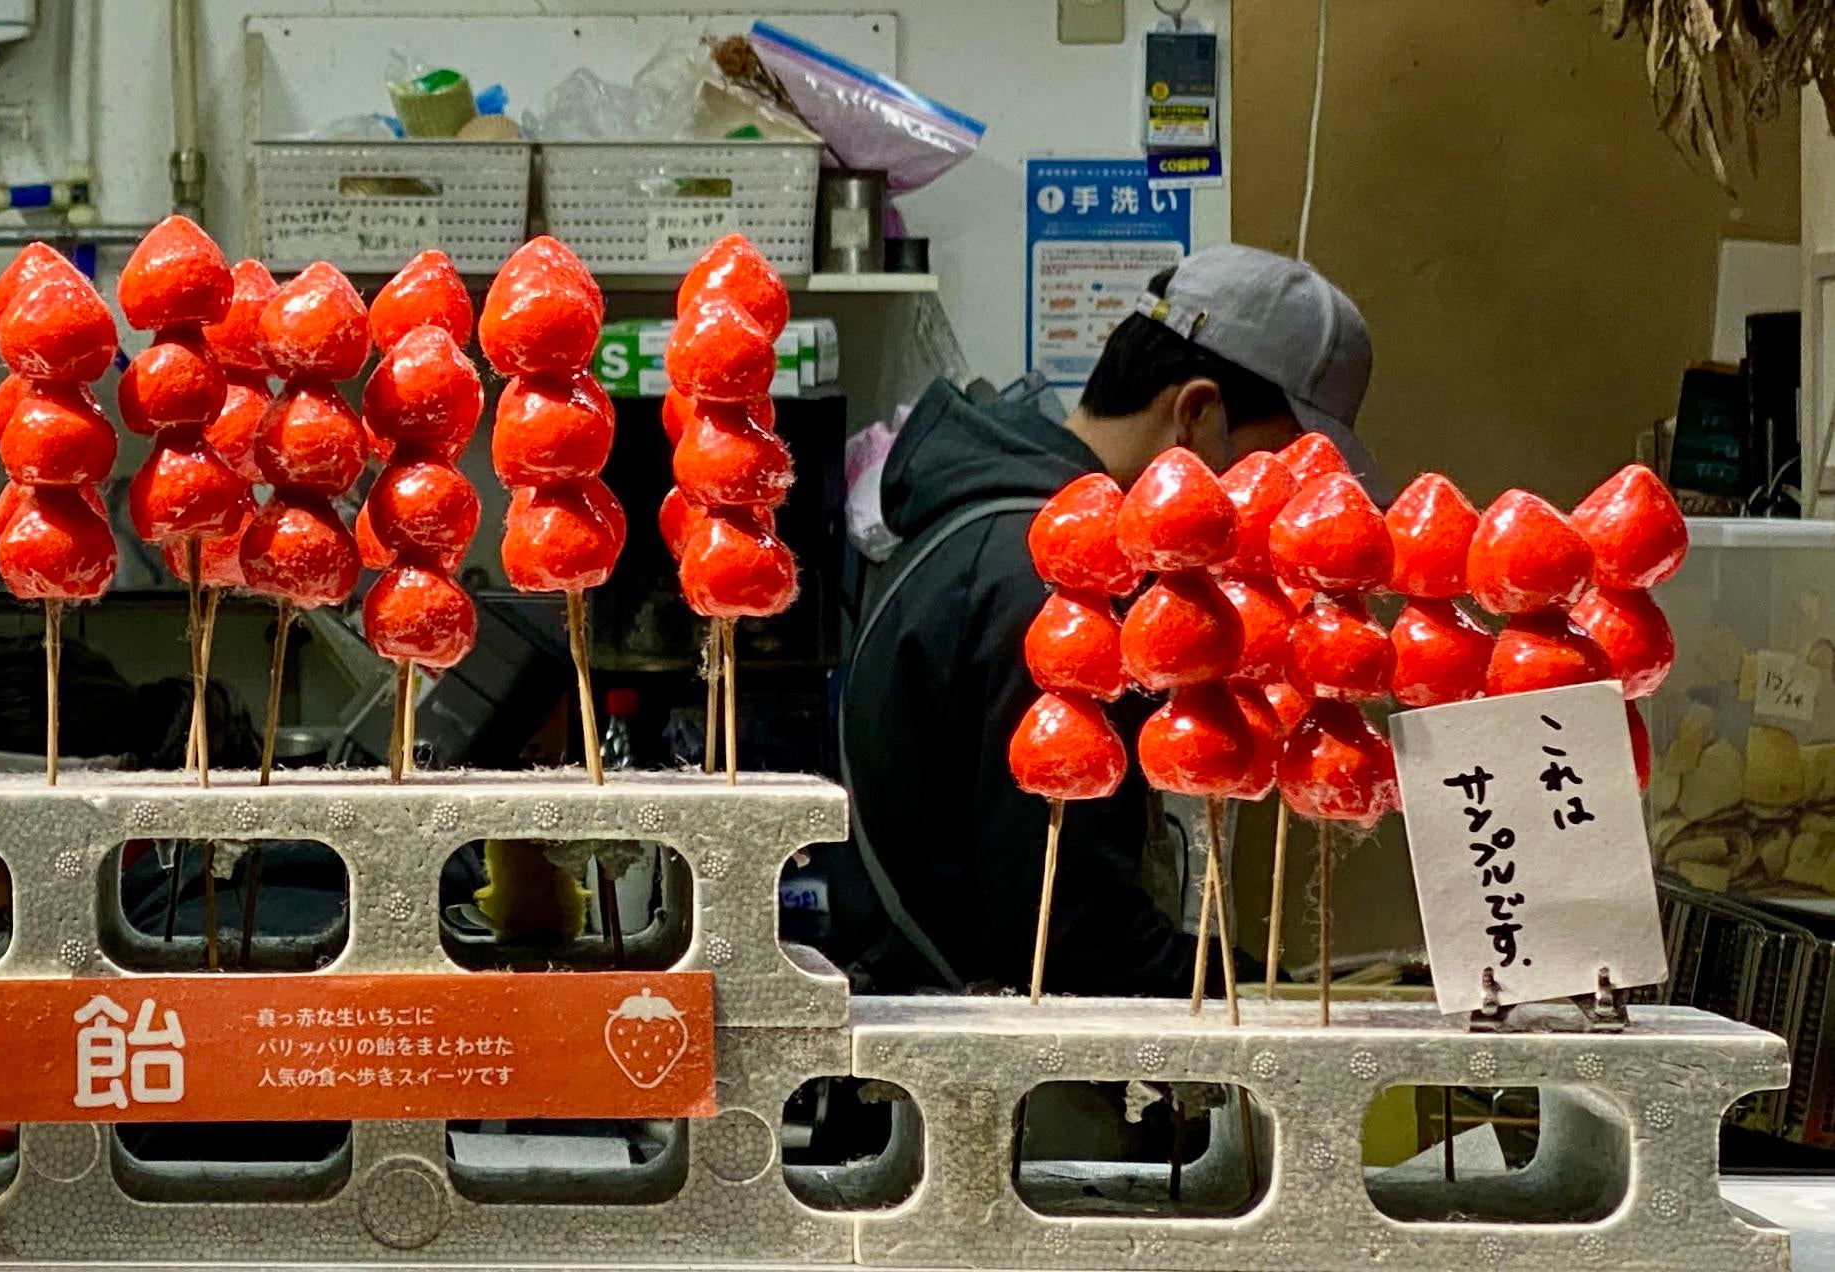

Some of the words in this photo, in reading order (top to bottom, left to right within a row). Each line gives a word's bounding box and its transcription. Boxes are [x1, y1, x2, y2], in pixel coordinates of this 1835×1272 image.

[600, 343, 630, 379] S
[1539, 714, 1596, 831] これは
[256, 1006, 436, 1028] 真っ赤な生いちごに
